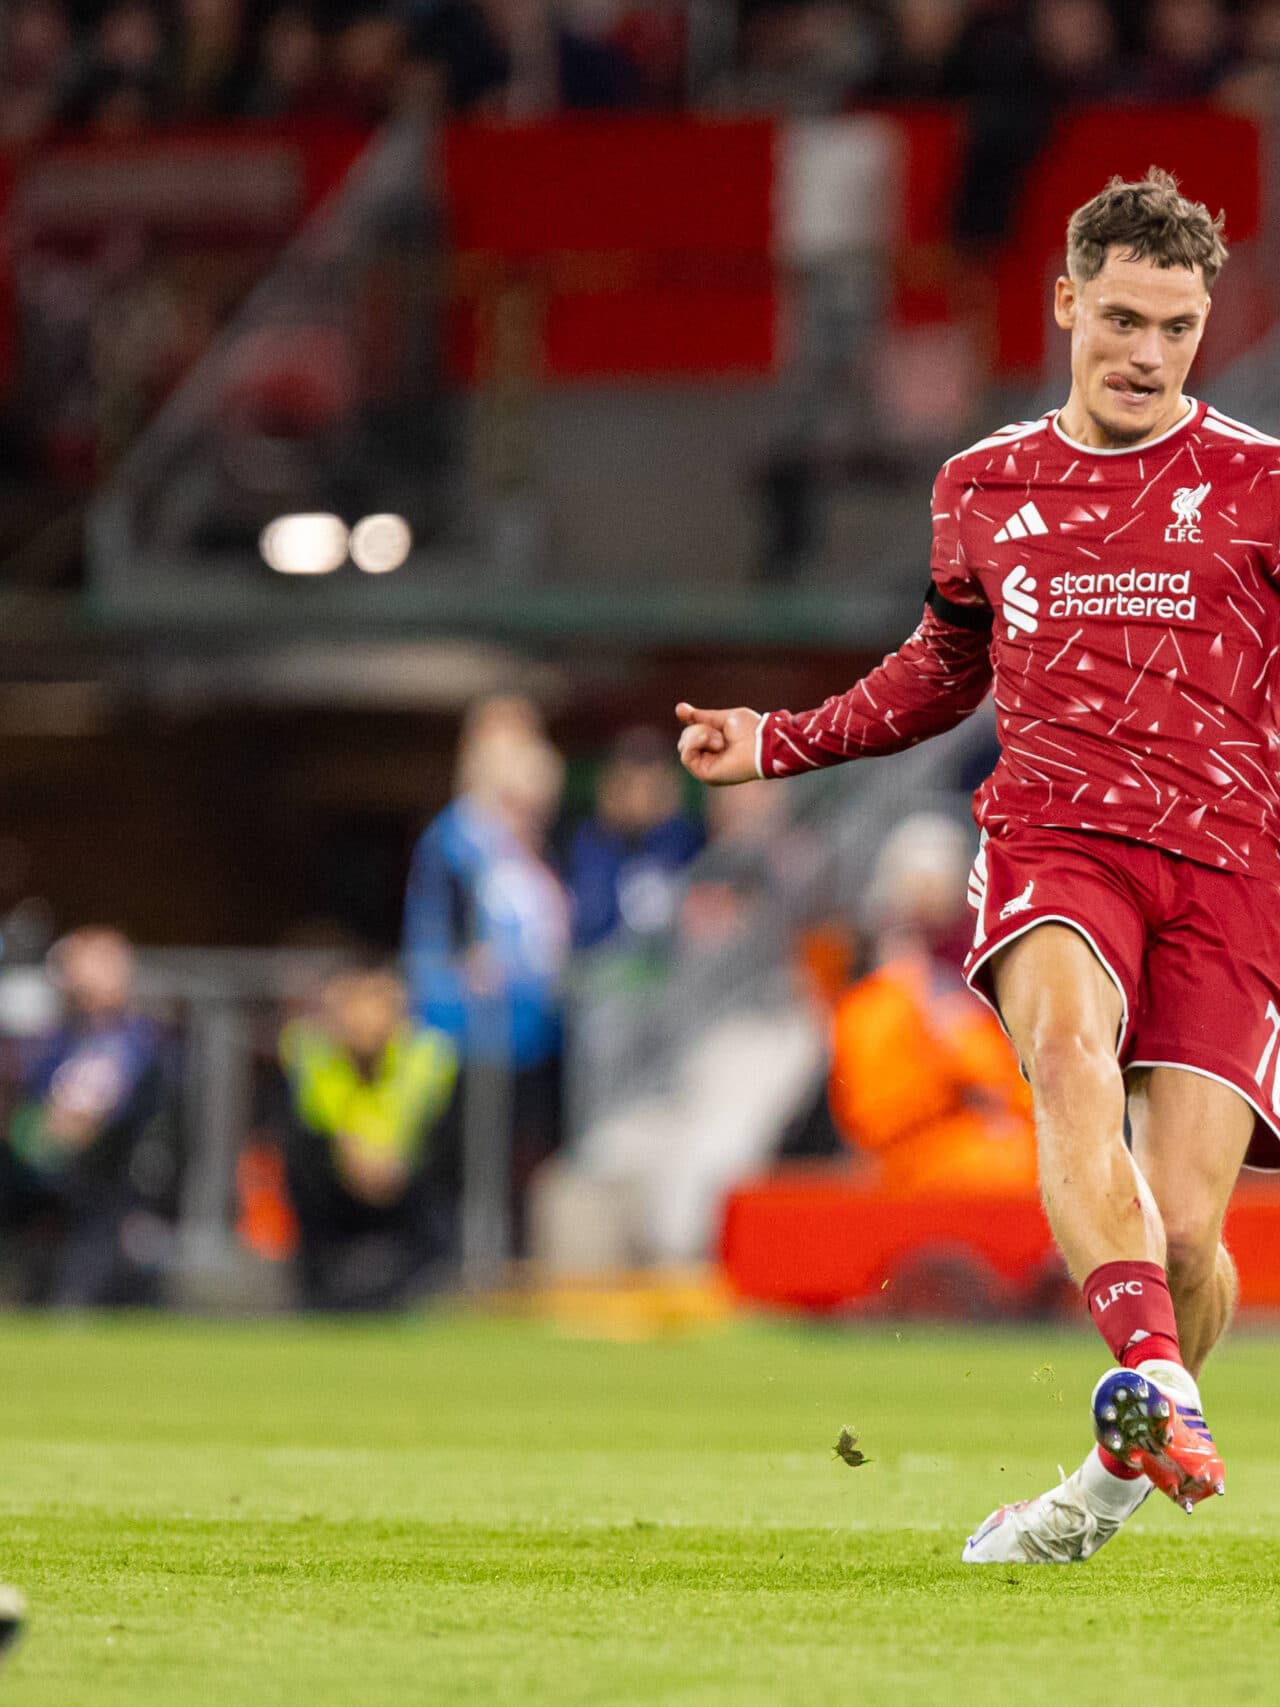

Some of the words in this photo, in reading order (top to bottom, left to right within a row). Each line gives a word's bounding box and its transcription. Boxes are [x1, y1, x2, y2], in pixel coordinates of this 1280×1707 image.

[1050, 568, 1191, 596] standard
[1050, 593, 1196, 621] chartered
[1095, 1280, 1143, 1312] LFC
